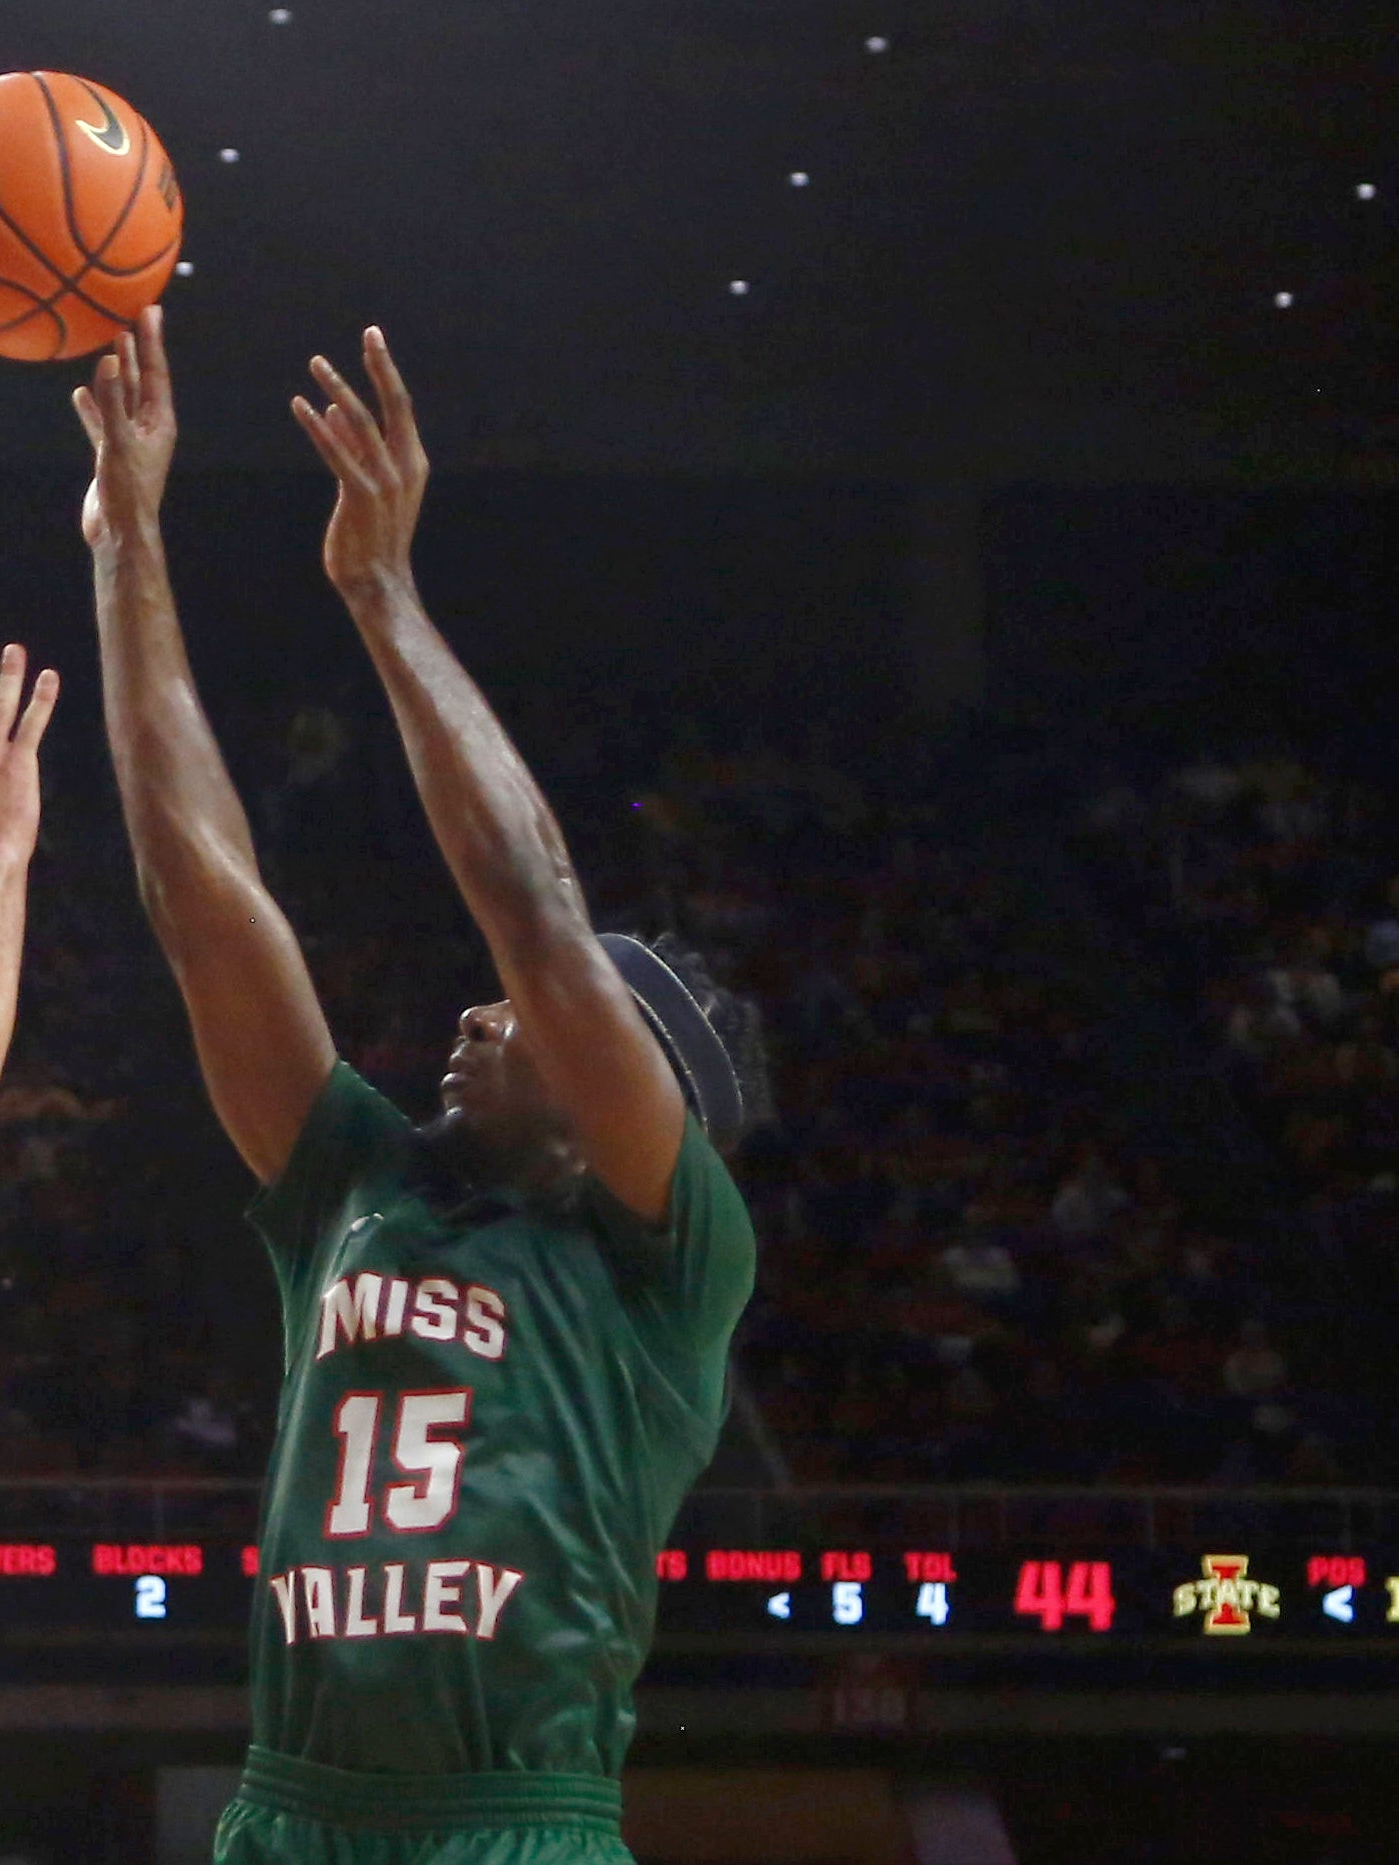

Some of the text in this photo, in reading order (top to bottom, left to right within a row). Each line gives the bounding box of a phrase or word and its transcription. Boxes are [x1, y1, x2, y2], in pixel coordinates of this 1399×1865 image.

[315, 1270, 508, 1362] MISS
[323, 1386, 474, 1540] 15
[92, 1543, 203, 1575] BLOCKS
[706, 1550, 802, 1582] BONUS
[820, 1551, 873, 1582] FLS
[1306, 1555, 1368, 1587] POS
[134, 1575, 167, 1619] 2
[269, 1558, 525, 1646] VALLEY
[832, 1581, 864, 1626] 5
[915, 1581, 950, 1626] 4
[1015, 1560, 1116, 1632] 44
[1172, 1578, 1281, 1619] STATE
